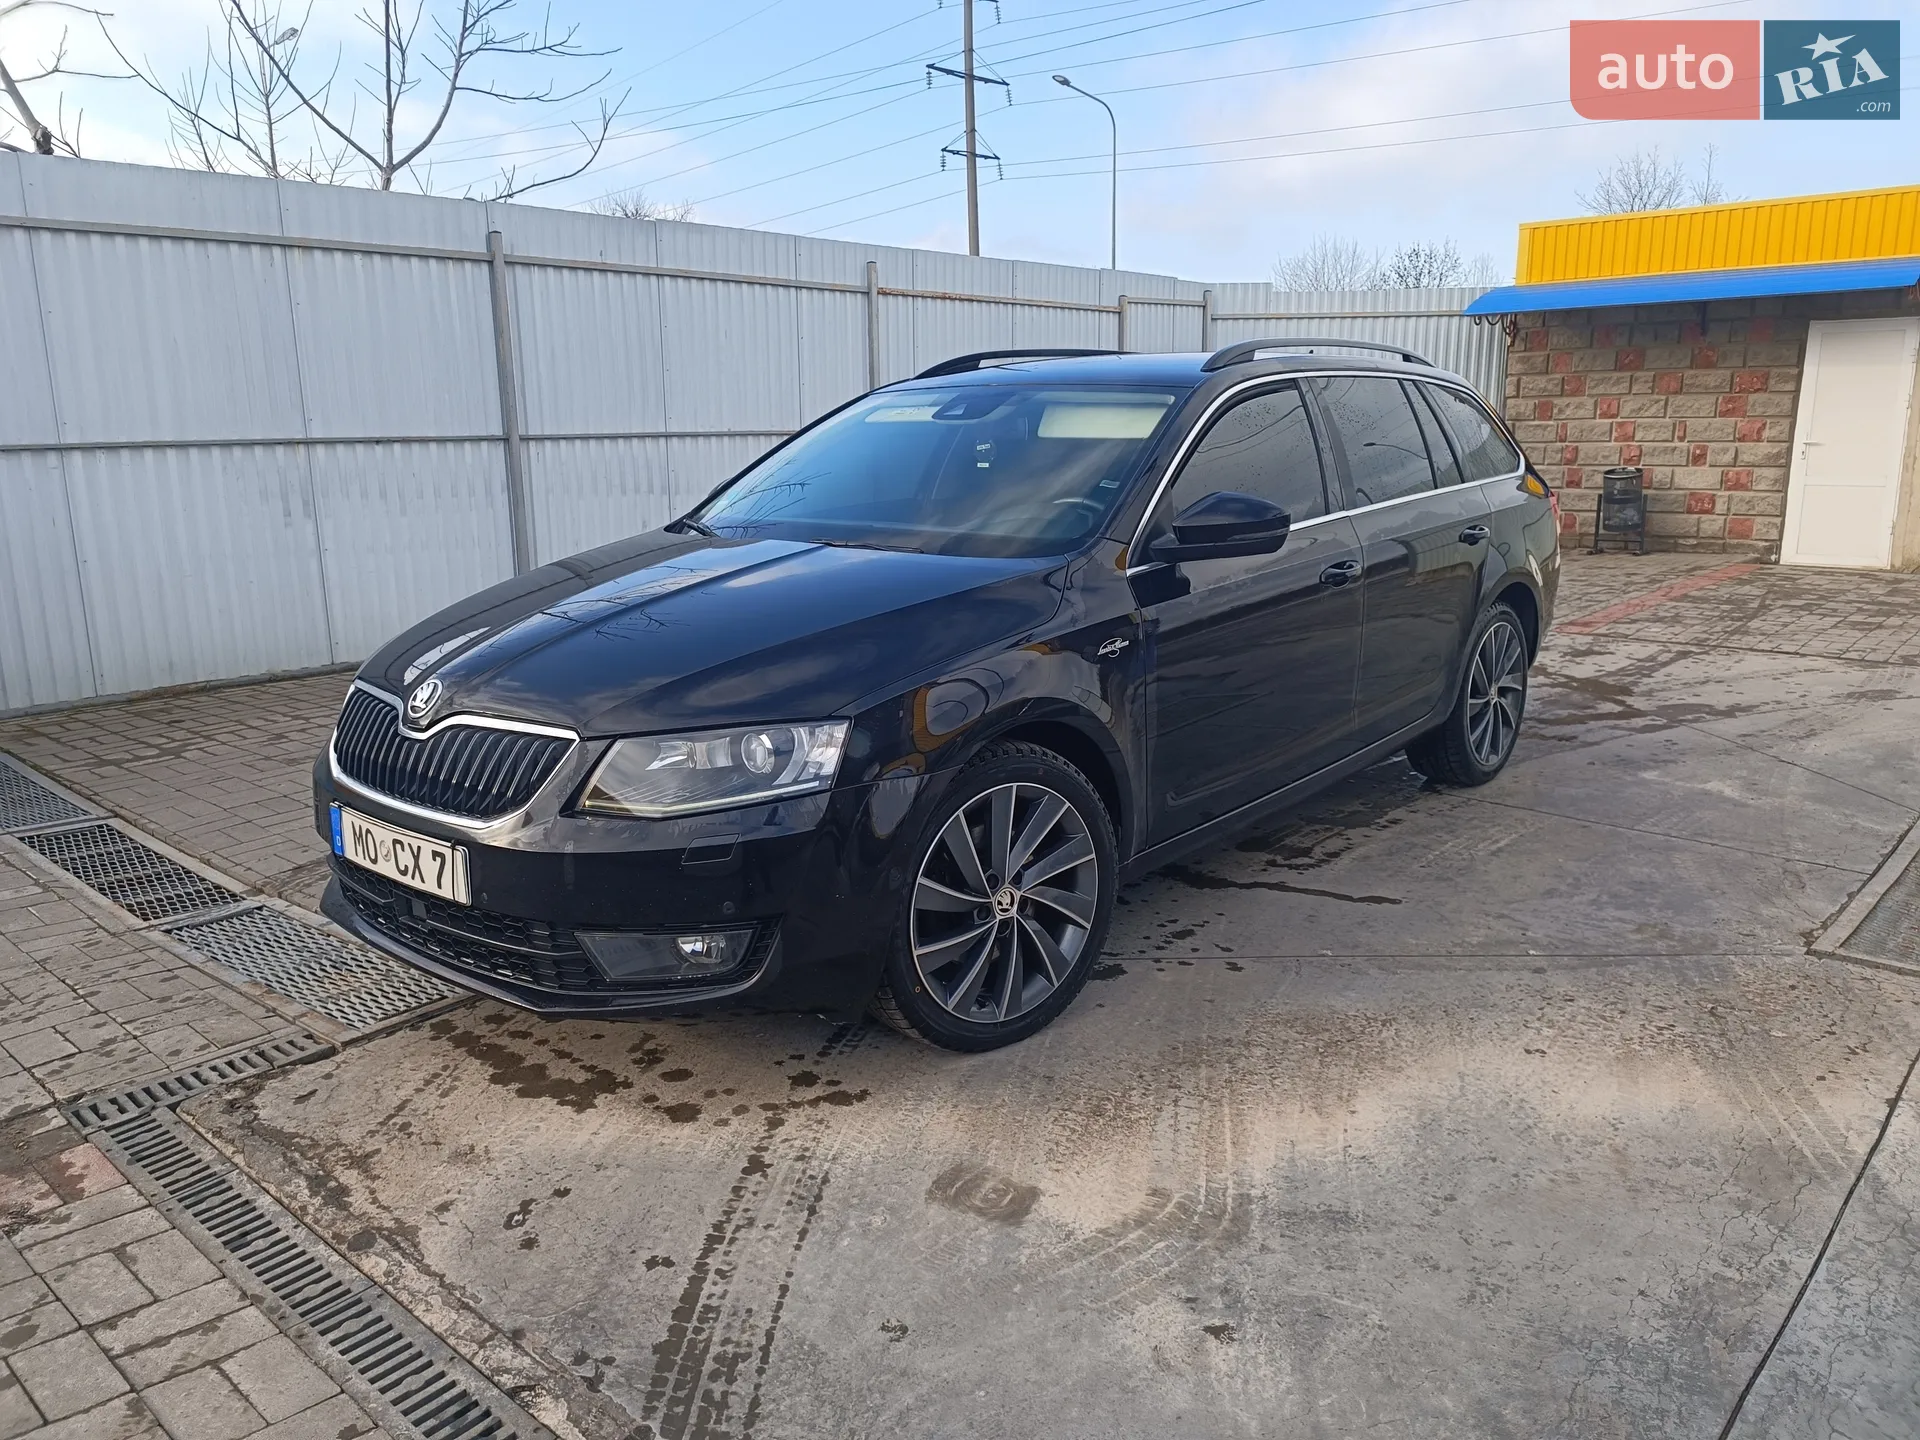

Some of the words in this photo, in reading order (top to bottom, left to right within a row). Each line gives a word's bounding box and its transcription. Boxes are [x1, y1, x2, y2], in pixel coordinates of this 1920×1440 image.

[351, 820, 379, 865] MO
[392, 838, 426, 884] CX
[431, 849, 447, 890] 7
